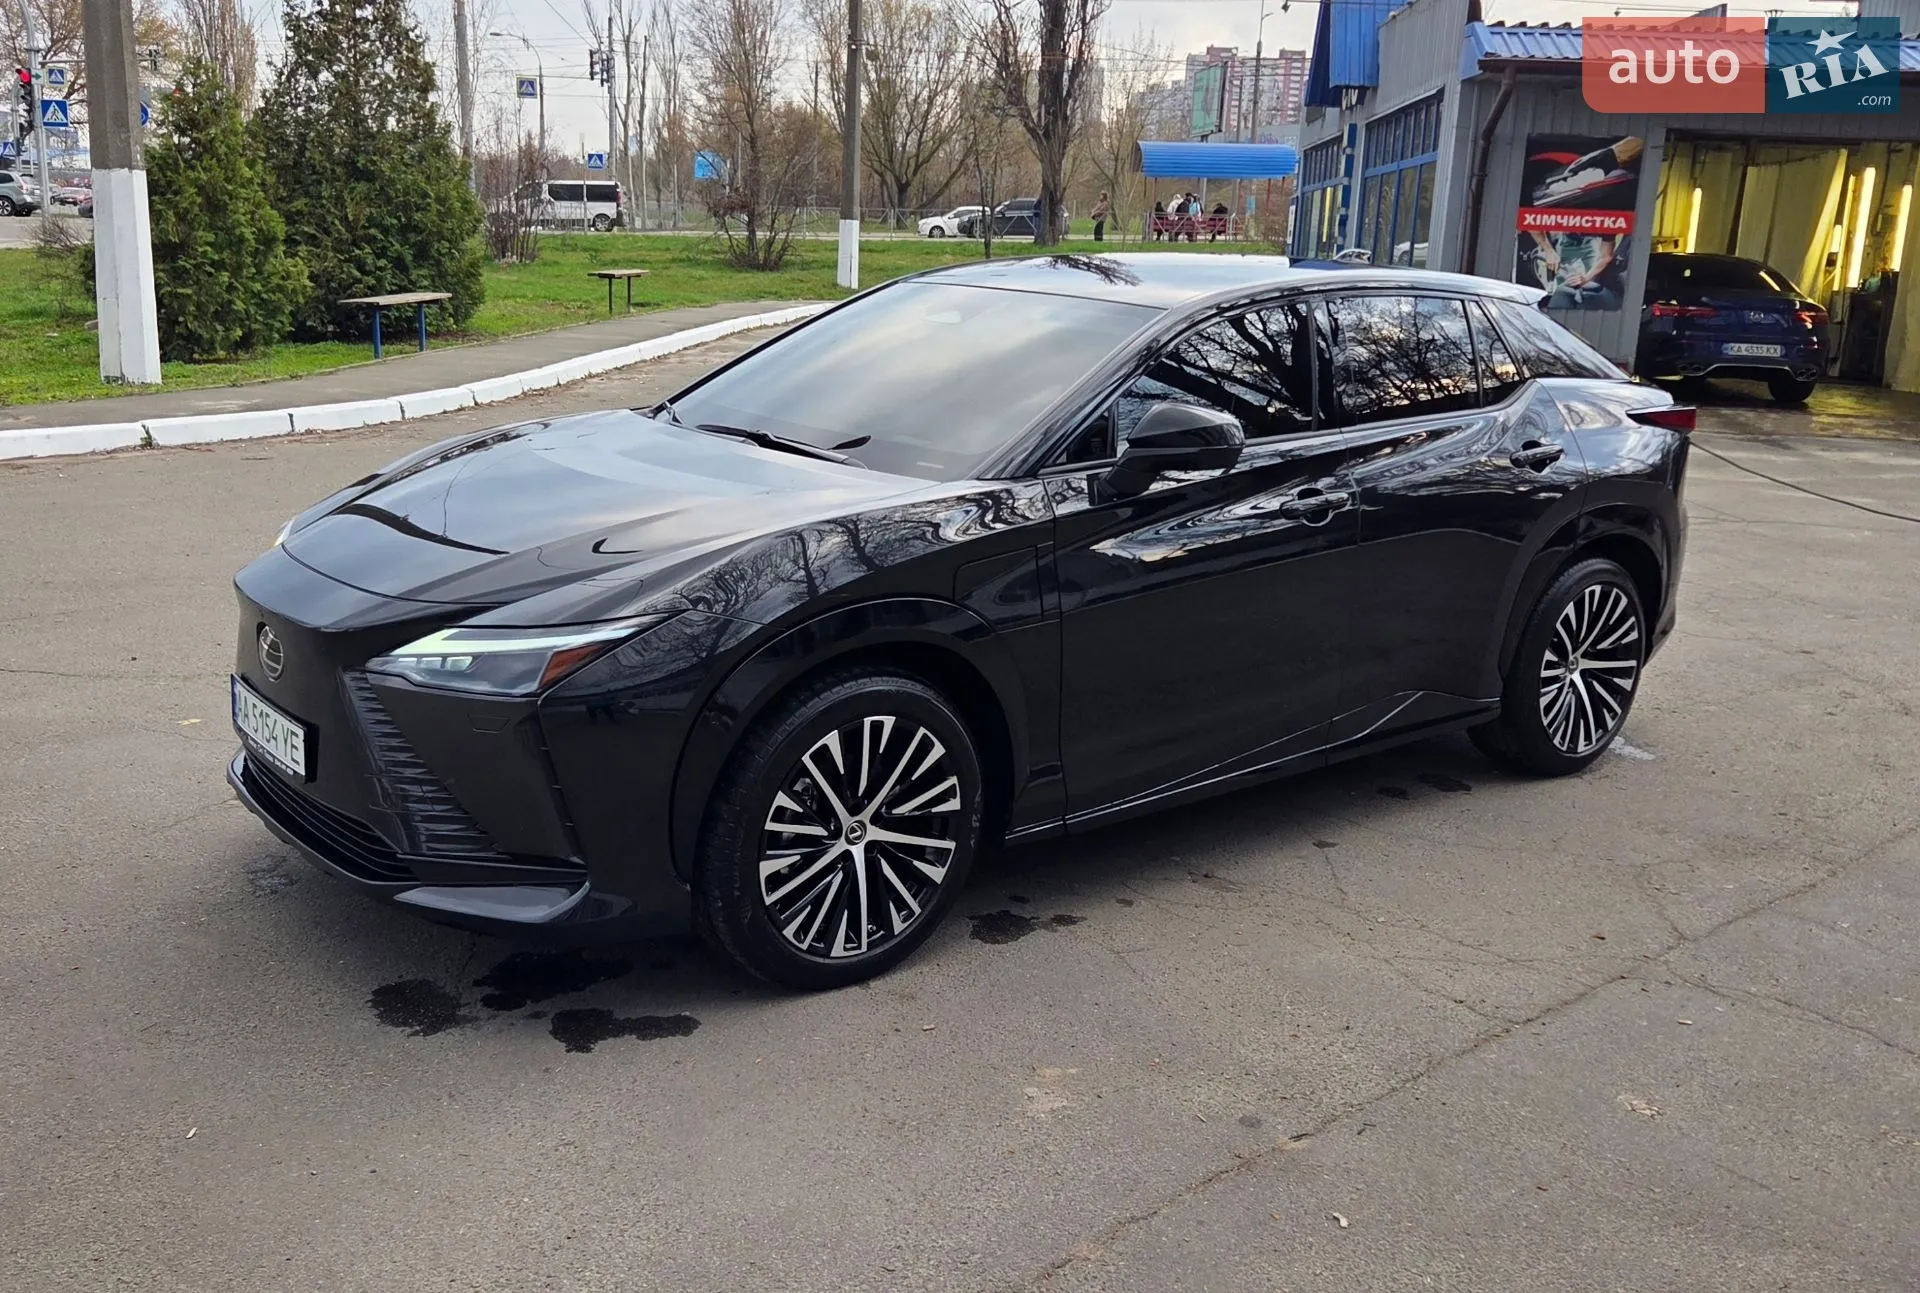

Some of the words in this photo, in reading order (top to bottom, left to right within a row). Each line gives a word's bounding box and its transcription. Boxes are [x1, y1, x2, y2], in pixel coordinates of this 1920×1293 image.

[1523, 213, 1627, 229] ХІМЧИСТКА
[252, 702, 279, 751] 5154
[281, 723, 300, 766] YE
